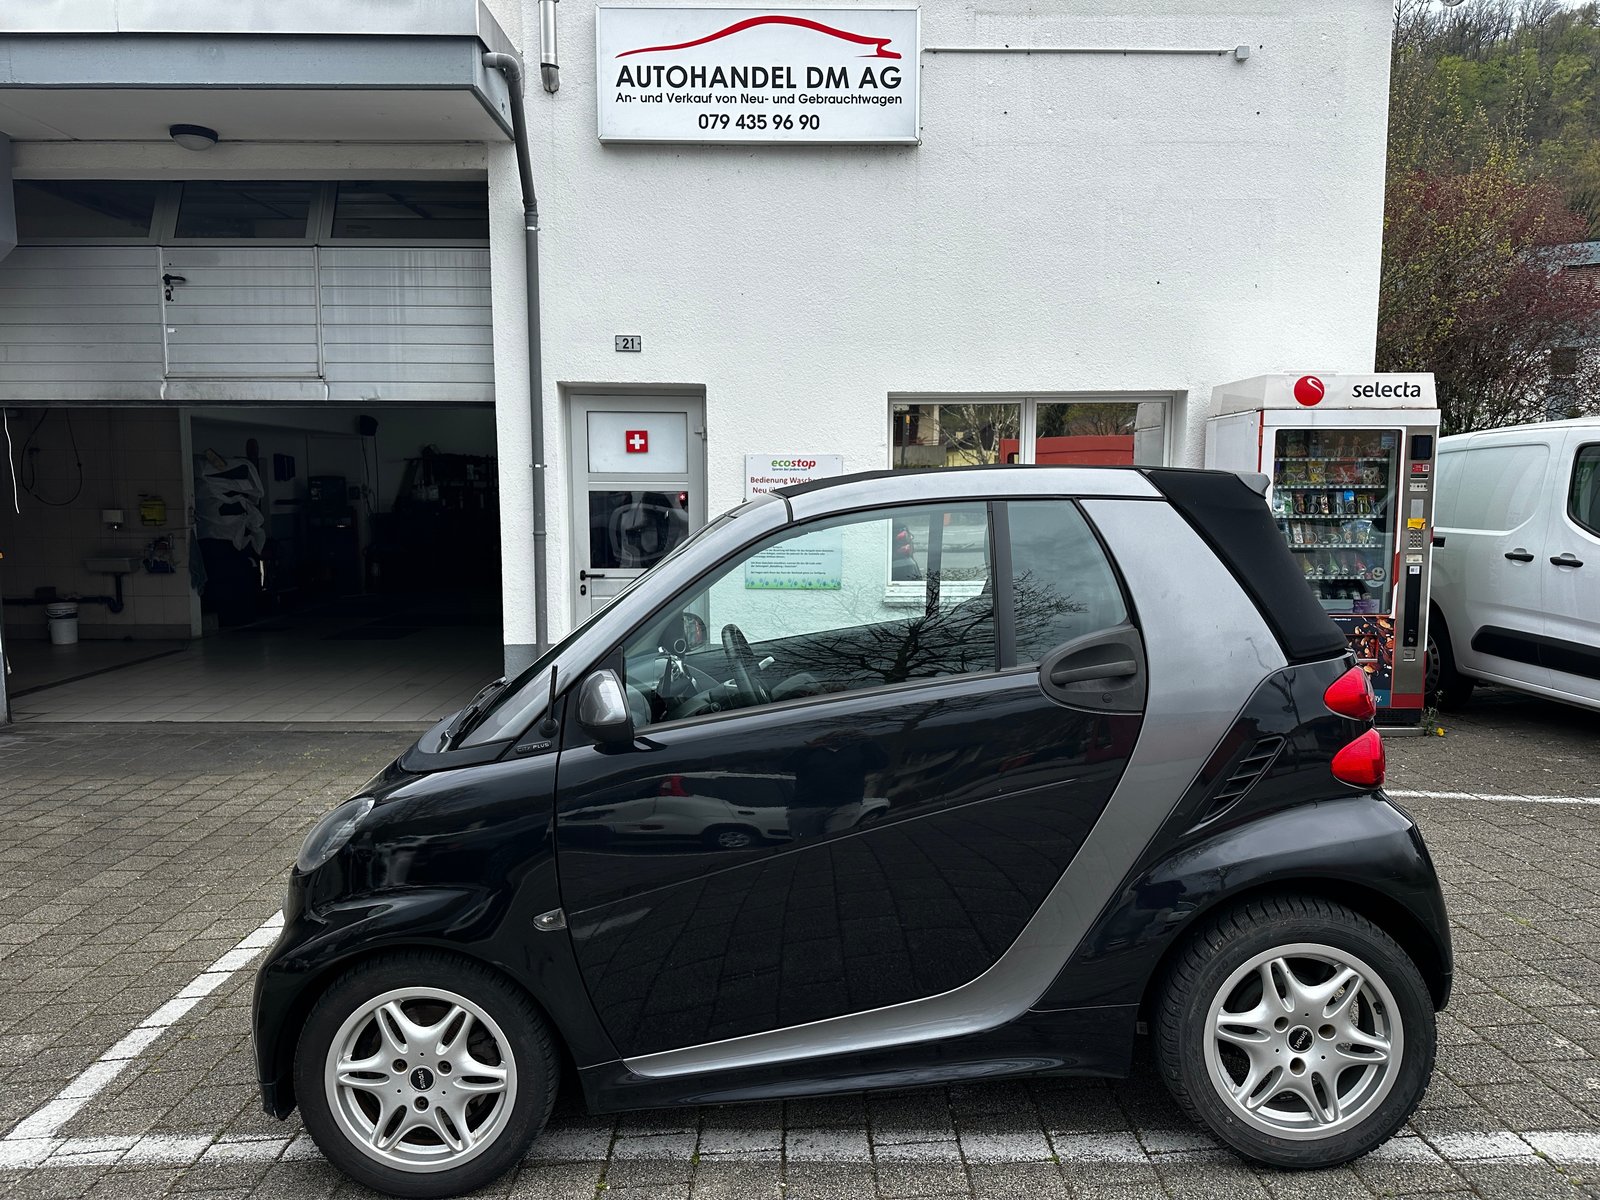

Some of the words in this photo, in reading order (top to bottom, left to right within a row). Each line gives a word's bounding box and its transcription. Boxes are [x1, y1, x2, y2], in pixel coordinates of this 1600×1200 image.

[615, 65, 797, 89] AUTOHANDEL
[806, 66, 850, 89] DM
[858, 66, 902, 90] AG
[615, 92, 637, 103] An-
[640, 92, 663, 104] und
[666, 92, 713, 104] Verkauf
[715, 95, 737, 104] von
[740, 93, 769, 105] Neu-
[772, 93, 795, 105] und
[798, 93, 903, 107] Gebrauchtwagen
[698, 113, 730, 130] 079
[735, 113, 767, 130] 435
[772, 114, 794, 130] 96
[799, 114, 820, 130] 90
[622, 337, 635, 350] 21
[1351, 381, 1421, 398] selecta
[771, 459, 816, 469] ecostop
[750, 476, 788, 485] Bedienung
[1356, 1103, 1406, 1146] YOKOHAMA
